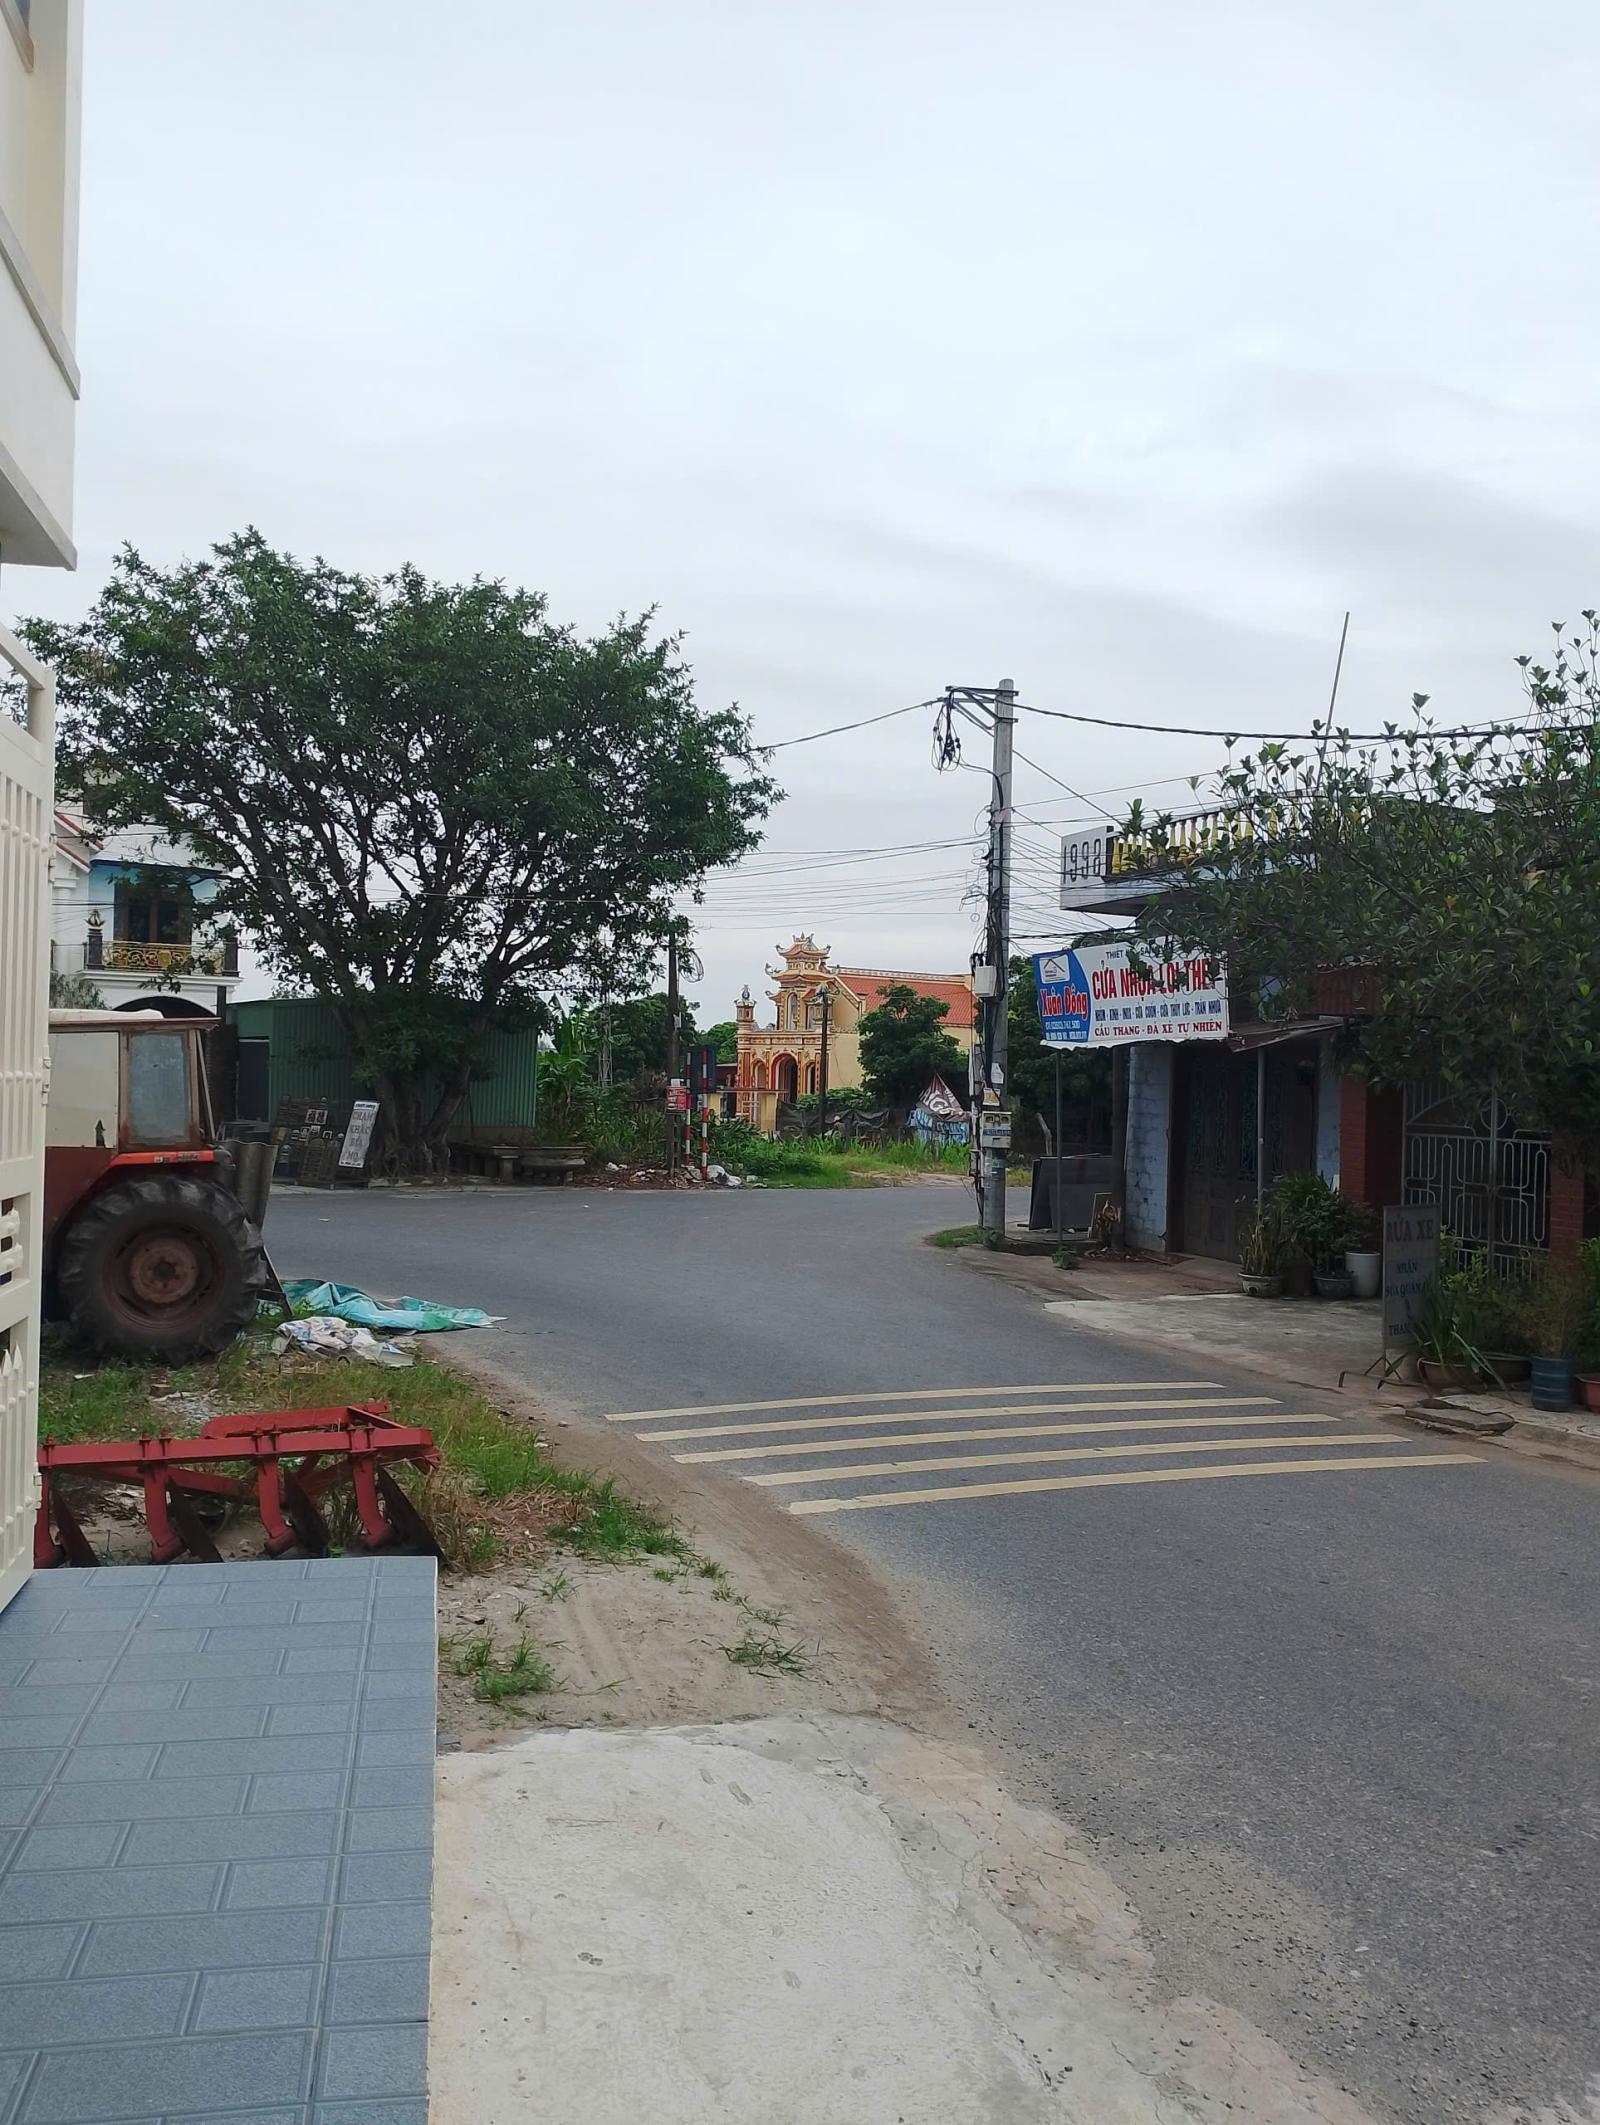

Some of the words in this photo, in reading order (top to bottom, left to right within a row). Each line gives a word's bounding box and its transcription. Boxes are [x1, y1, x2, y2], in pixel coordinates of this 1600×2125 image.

[1092, 960, 1117, 1000] CỬA
[1040, 985, 1063, 1017] Xuân
[1113, 1025, 1140, 1036] THANG
[1193, 1018, 1222, 1033] NHIÊN
[1416, 1219, 1434, 1240] XE
